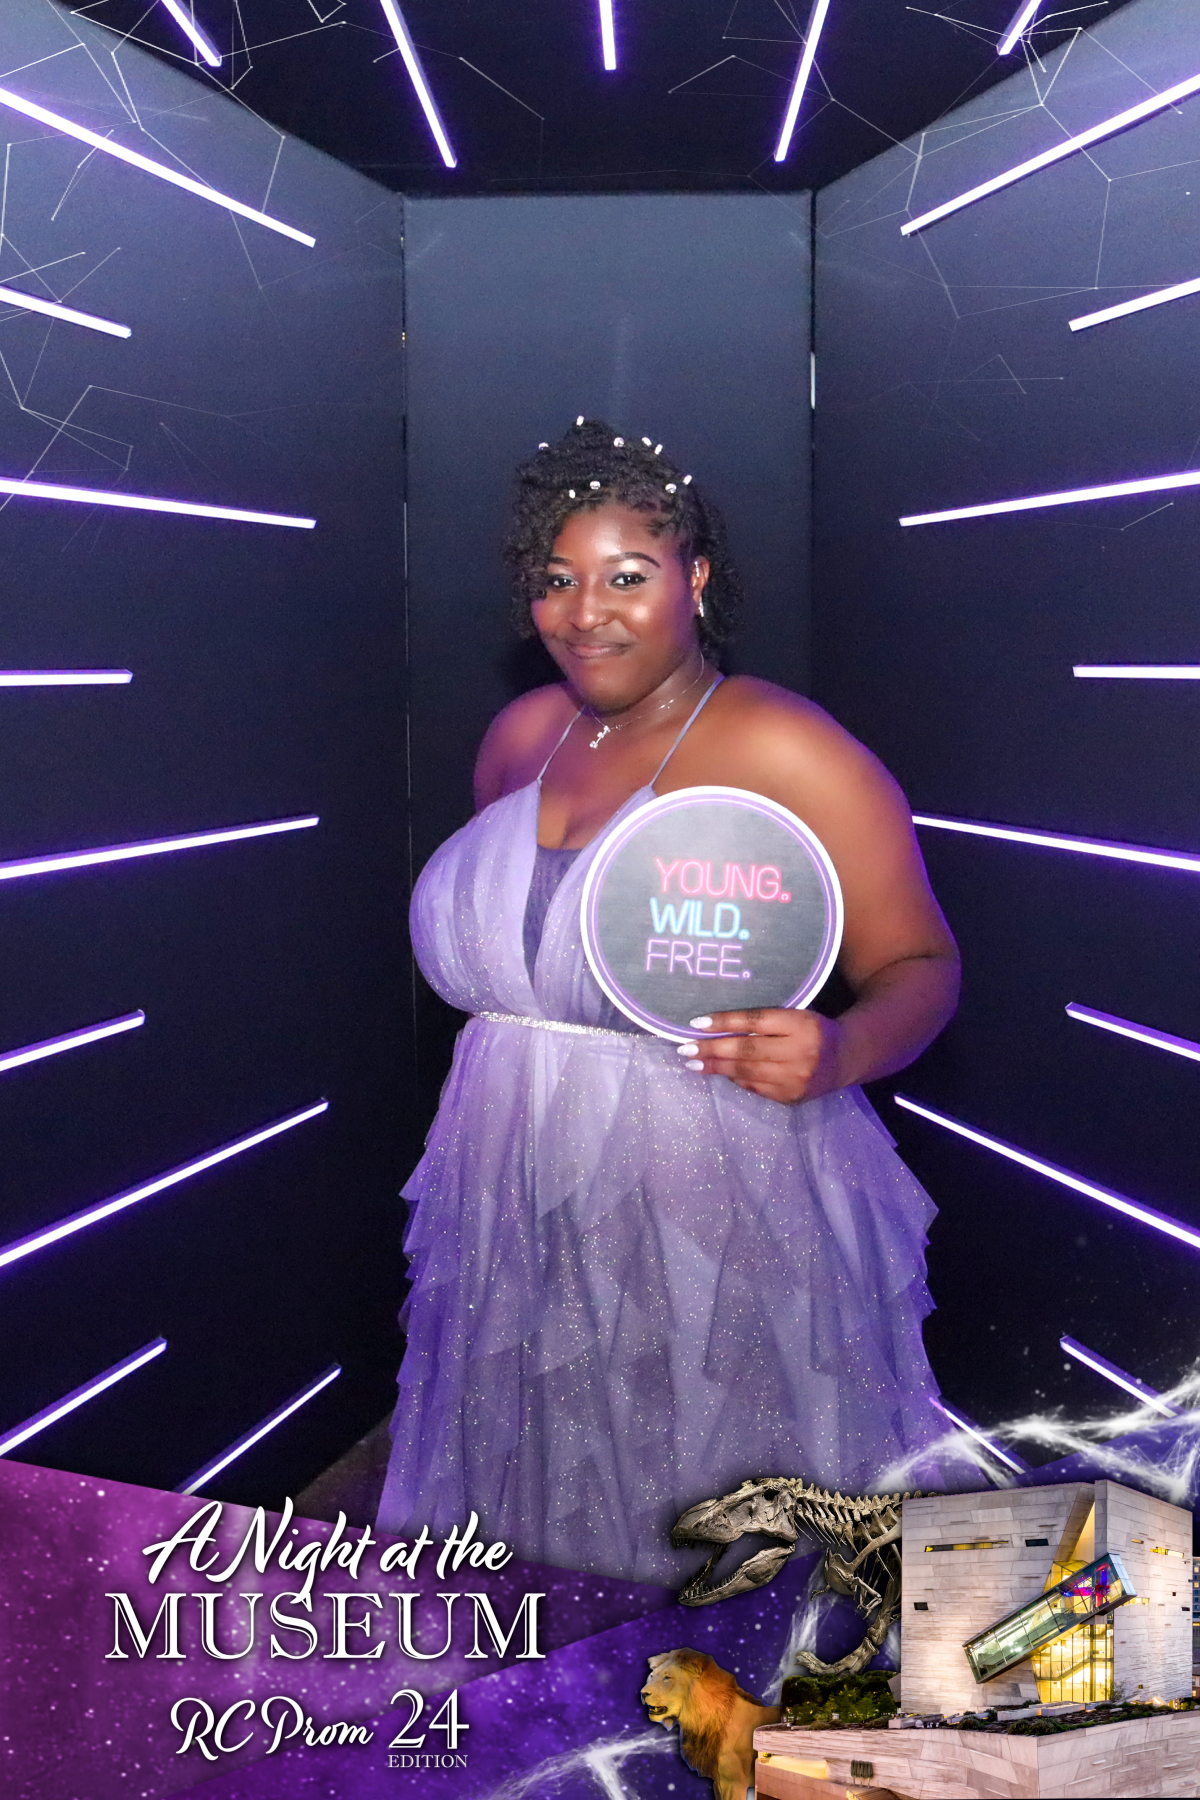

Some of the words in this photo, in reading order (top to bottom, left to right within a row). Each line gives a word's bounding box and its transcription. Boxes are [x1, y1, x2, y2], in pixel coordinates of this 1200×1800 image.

[655, 857, 791, 903] YOUNG.
[650, 897, 749, 940] WILD.
[645, 939, 752, 979] FREE.
